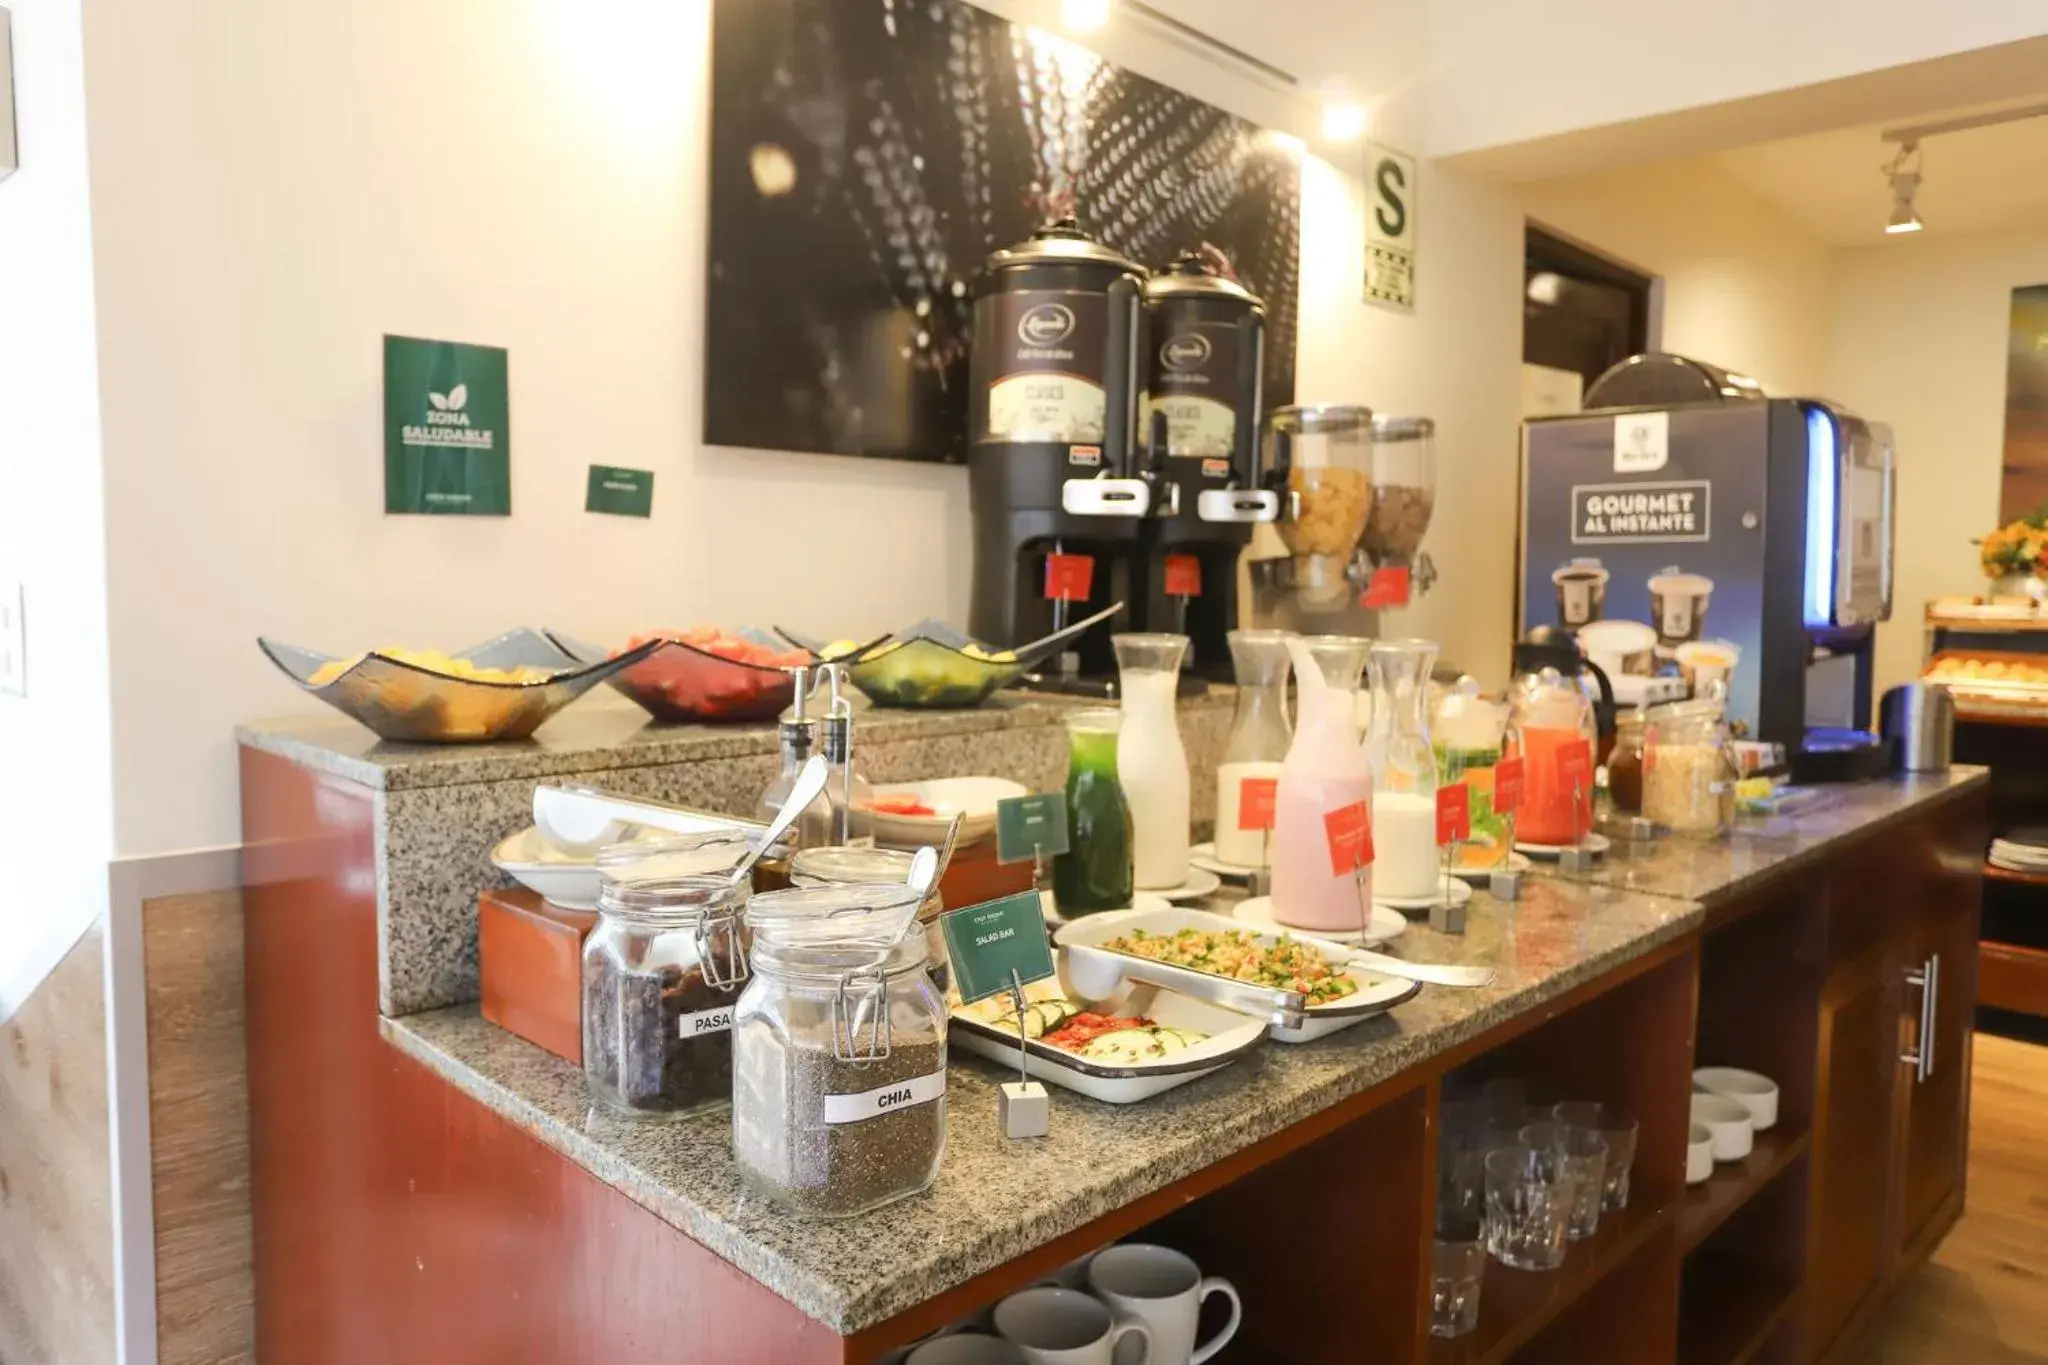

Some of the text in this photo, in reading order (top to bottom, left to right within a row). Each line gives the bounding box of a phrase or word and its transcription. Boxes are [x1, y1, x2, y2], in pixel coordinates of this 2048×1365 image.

[1376, 158, 1406, 237] S
[426, 410, 471, 426] ZONA
[402, 425, 493, 444] SALUDABLE
[1587, 493, 1694, 515] GOURMET
[1584, 513, 1695, 533] AL INSTANTE
[975, 927, 1015, 946] SALAD BAR
[695, 1013, 731, 1032] PASA
[878, 1088, 913, 1108] CHIA
